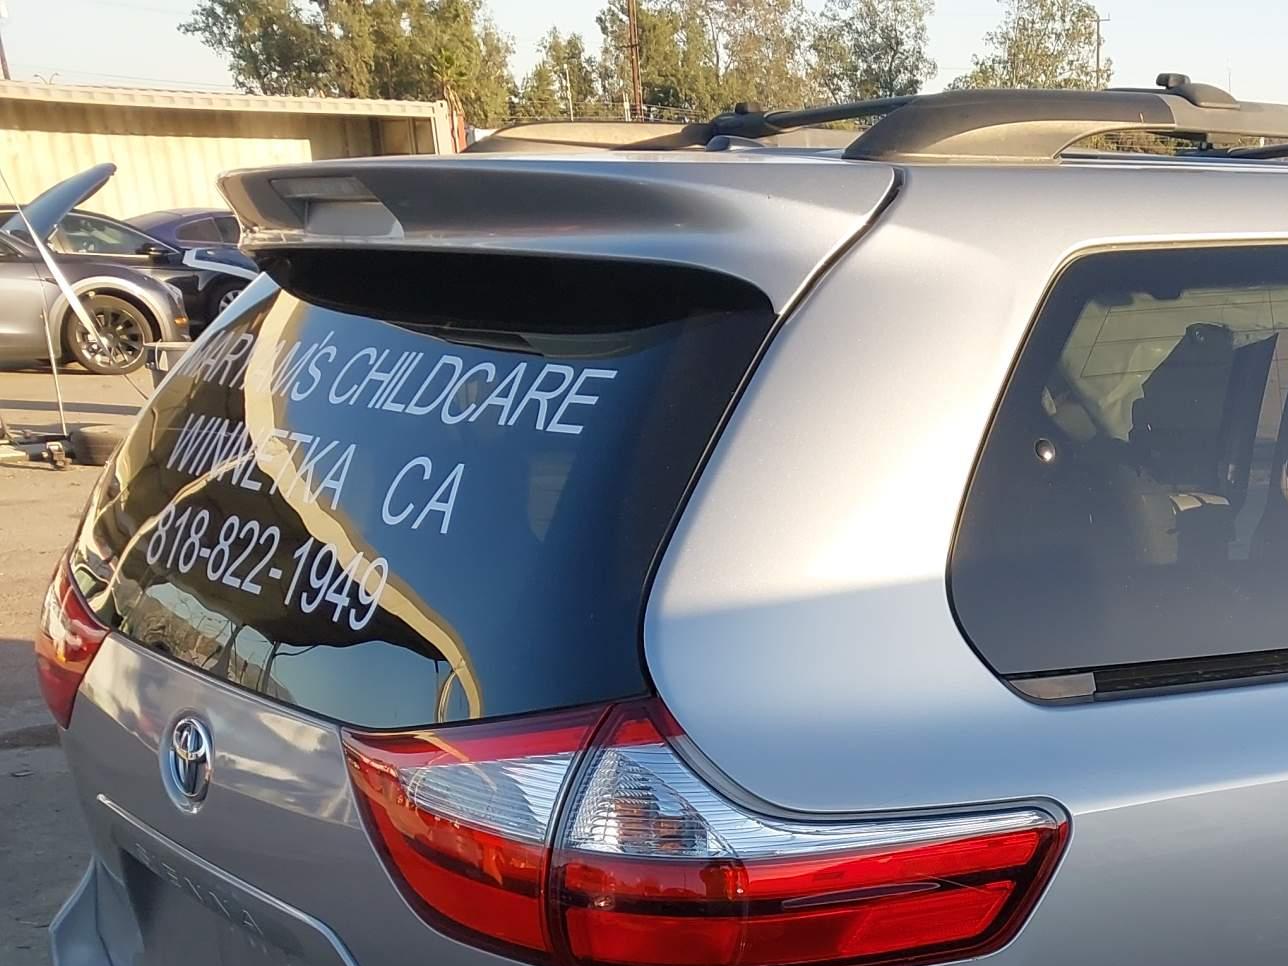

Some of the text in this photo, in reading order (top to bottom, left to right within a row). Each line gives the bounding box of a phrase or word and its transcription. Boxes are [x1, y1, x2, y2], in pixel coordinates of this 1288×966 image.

[328, 346, 618, 435] CHILDCARE
[166, 412, 465, 534] WINNETKA CA
[146, 504, 389, 631] 818-822-1949
